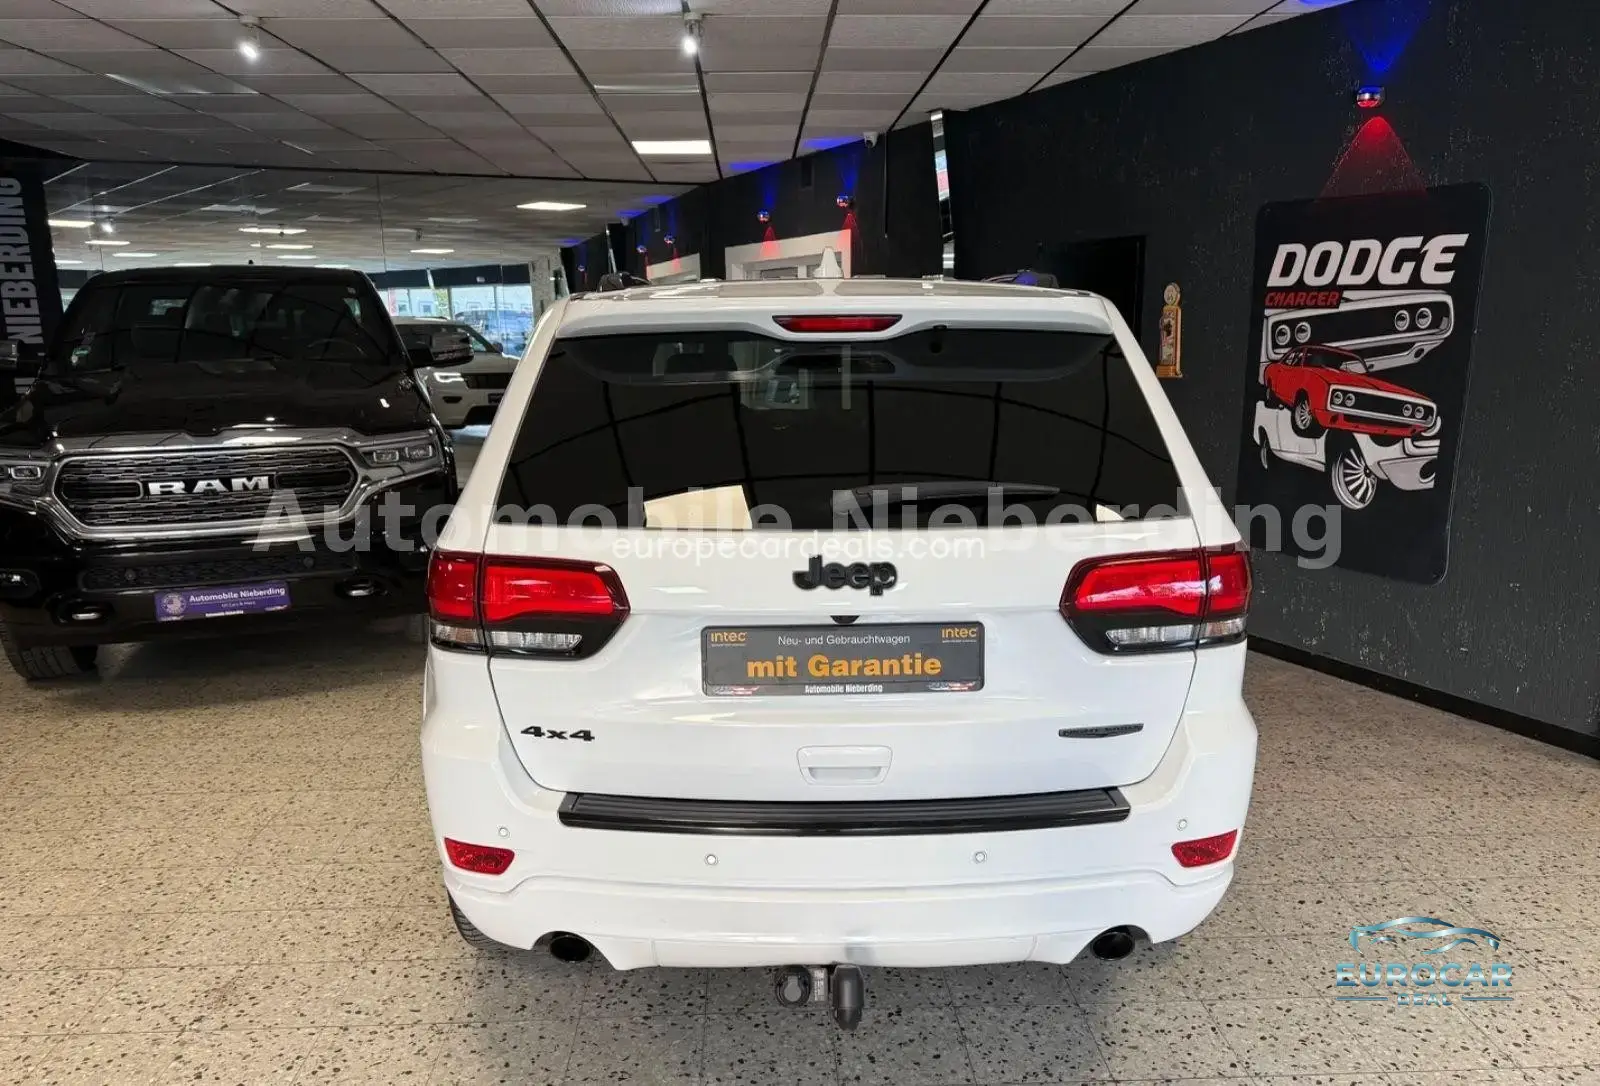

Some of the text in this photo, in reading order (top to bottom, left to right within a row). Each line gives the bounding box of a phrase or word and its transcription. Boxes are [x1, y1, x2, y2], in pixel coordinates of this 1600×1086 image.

[0, 177, 44, 344] NIEBERDING
[1266, 233, 1469, 288] DODGE
[1265, 291, 1340, 309] CHARGER
[148, 475, 271, 496] RAM
[793, 554, 898, 596] Jeep
[189, 587, 285, 602] Automobile Nieberding
[778, 633, 911, 647] Neu- und Gebrauchtwagen
[747, 653, 942, 678] mit Garantie
[805, 683, 883, 694] Automobile Nieberding
[520, 726, 595, 742] 4x4
